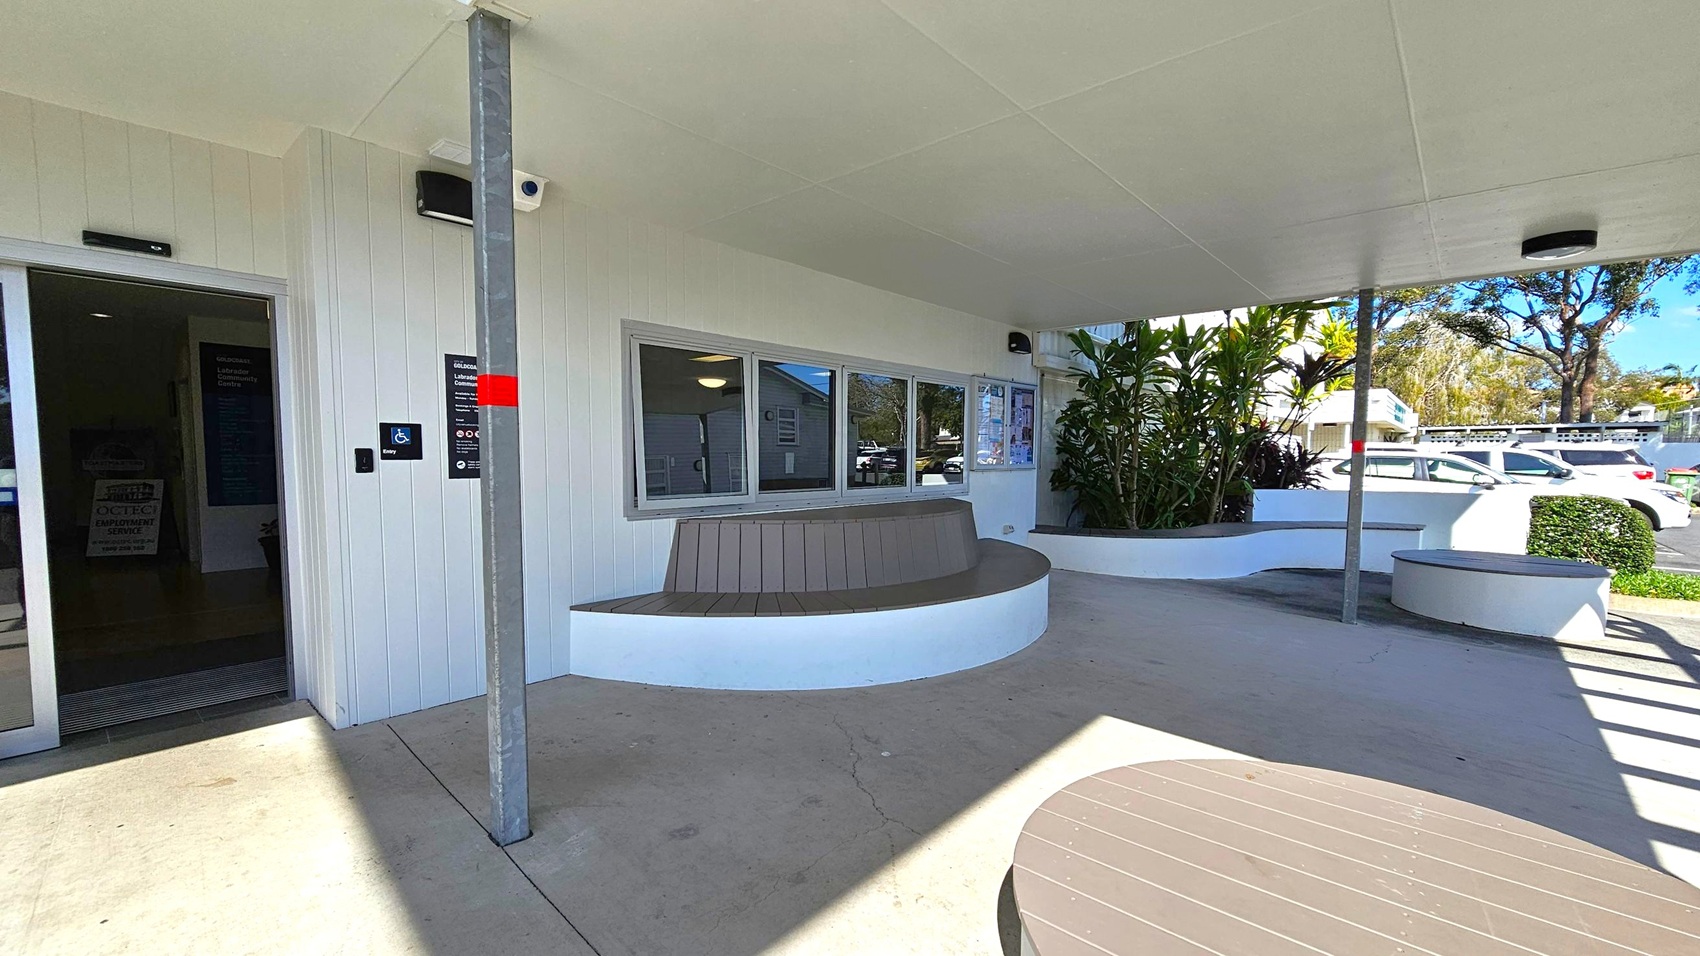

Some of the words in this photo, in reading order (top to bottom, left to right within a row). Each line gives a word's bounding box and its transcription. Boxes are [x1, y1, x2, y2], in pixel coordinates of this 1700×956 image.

[217, 367, 249, 375] Labrador
[217, 374, 258, 383] Community
[96, 505, 152, 516] OCTEC
[95, 518, 155, 528] EMPLOYMENT
[107, 527, 144, 536] SERVICE
